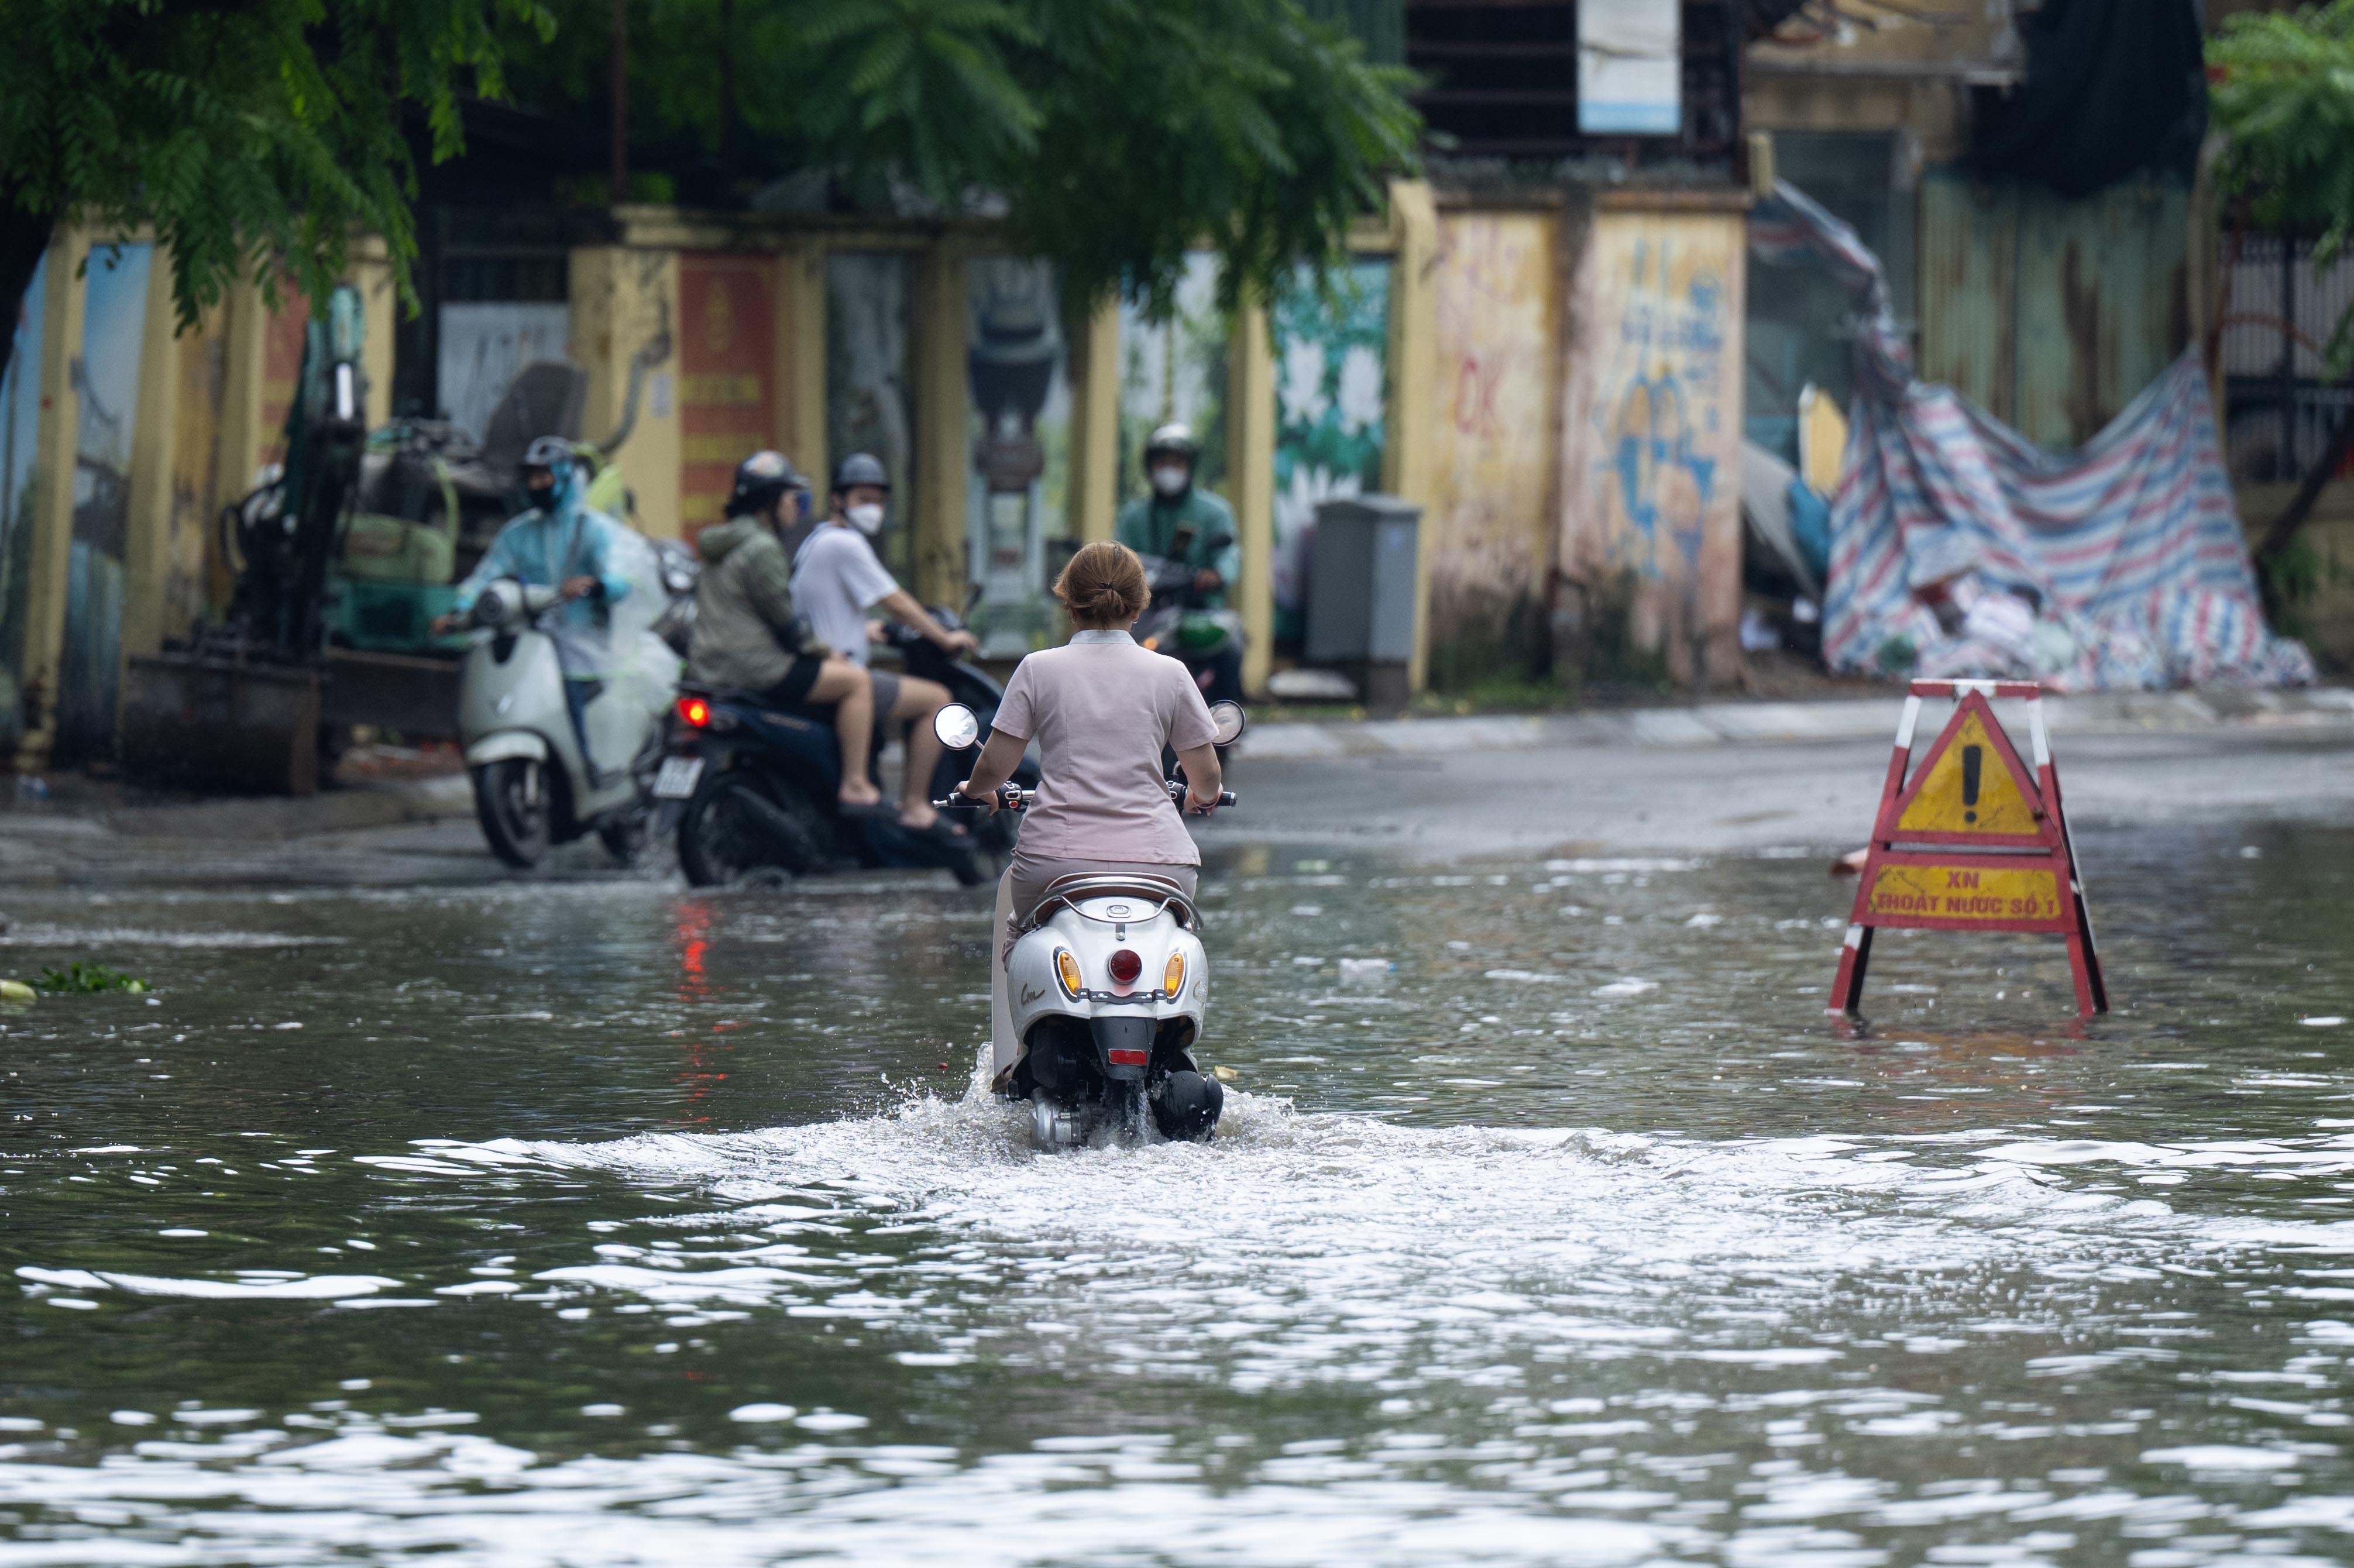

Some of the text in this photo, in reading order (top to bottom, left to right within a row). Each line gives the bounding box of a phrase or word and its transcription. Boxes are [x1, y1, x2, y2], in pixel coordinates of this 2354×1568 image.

[1946, 871, 1980, 889] XN
[1877, 889, 1939, 911] THOÁT
[2047, 900, 2054, 914] 1
